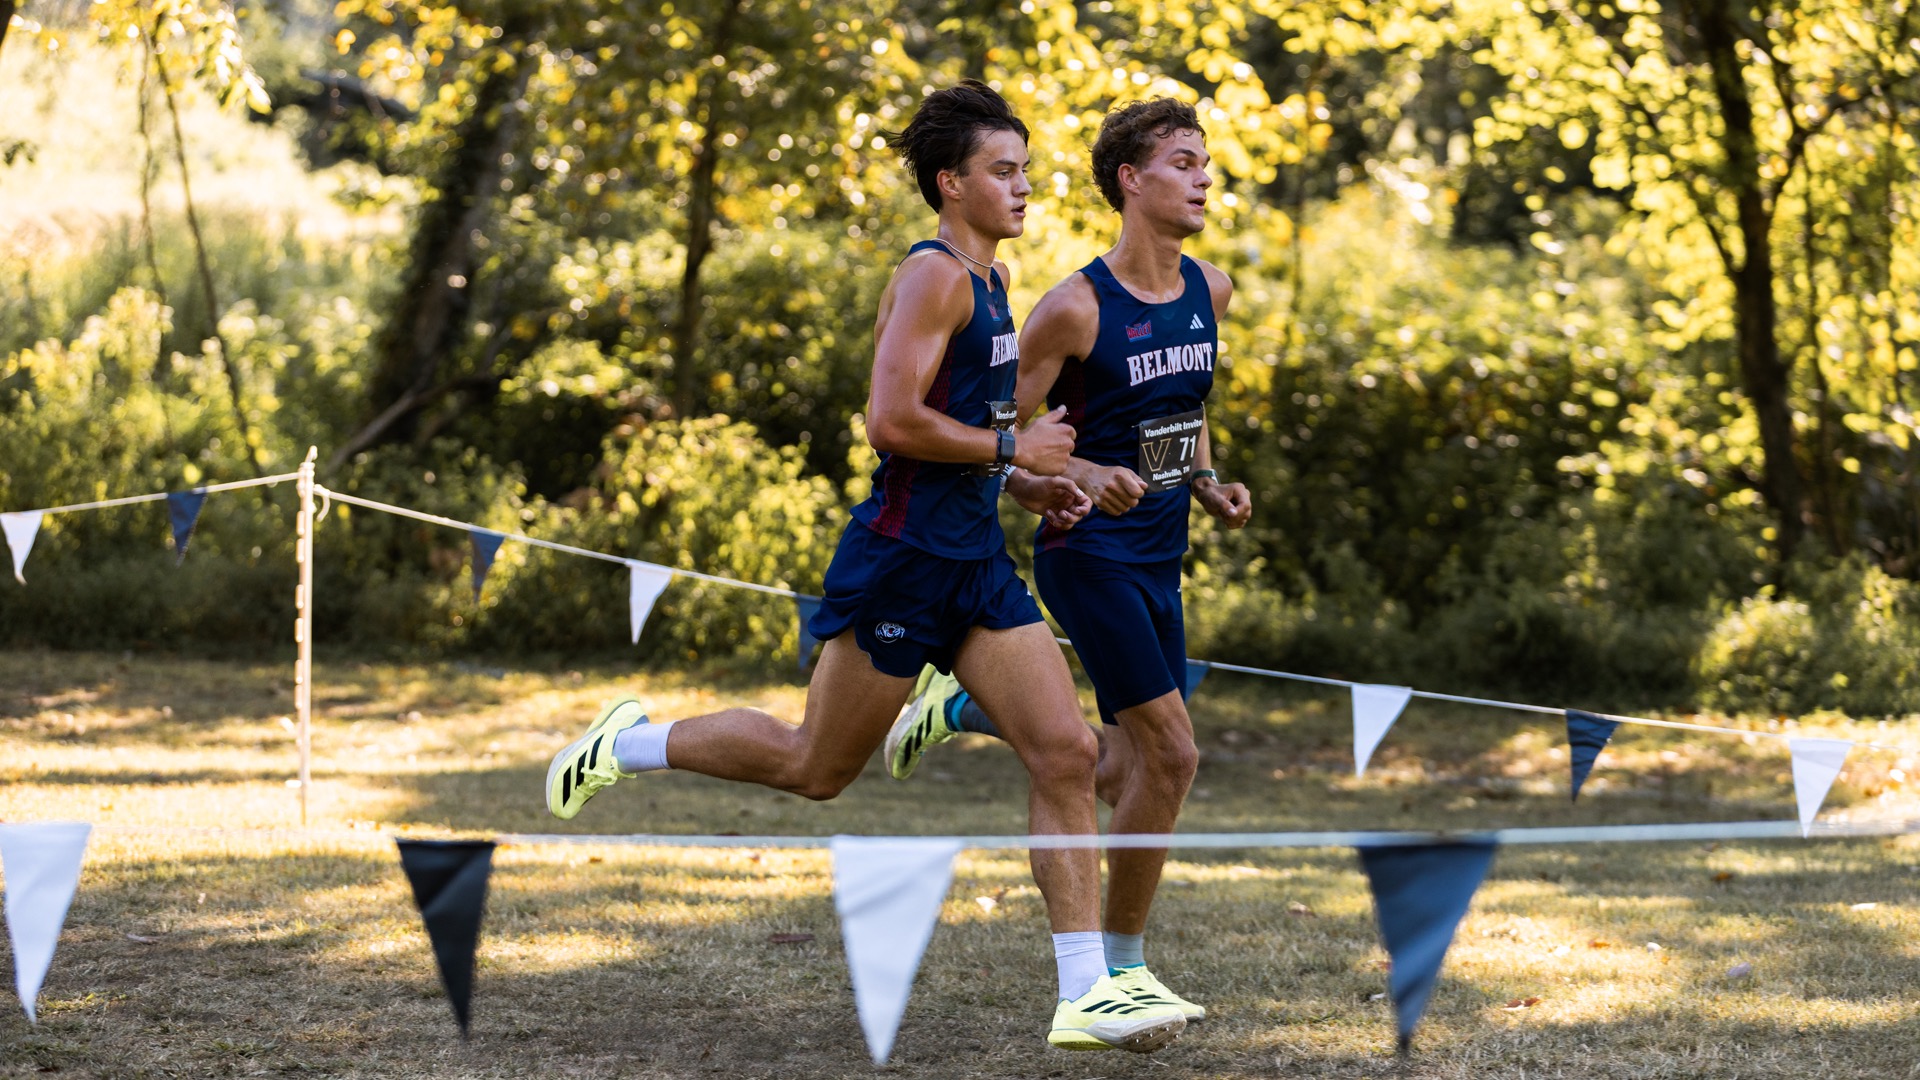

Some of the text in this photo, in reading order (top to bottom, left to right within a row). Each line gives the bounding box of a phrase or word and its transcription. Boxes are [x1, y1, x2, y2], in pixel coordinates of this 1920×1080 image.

[1126, 342, 1213, 387] BELMONT
[1144, 418, 1203, 438] Vanderbilt Invite
[1180, 435, 1196, 461] 71
